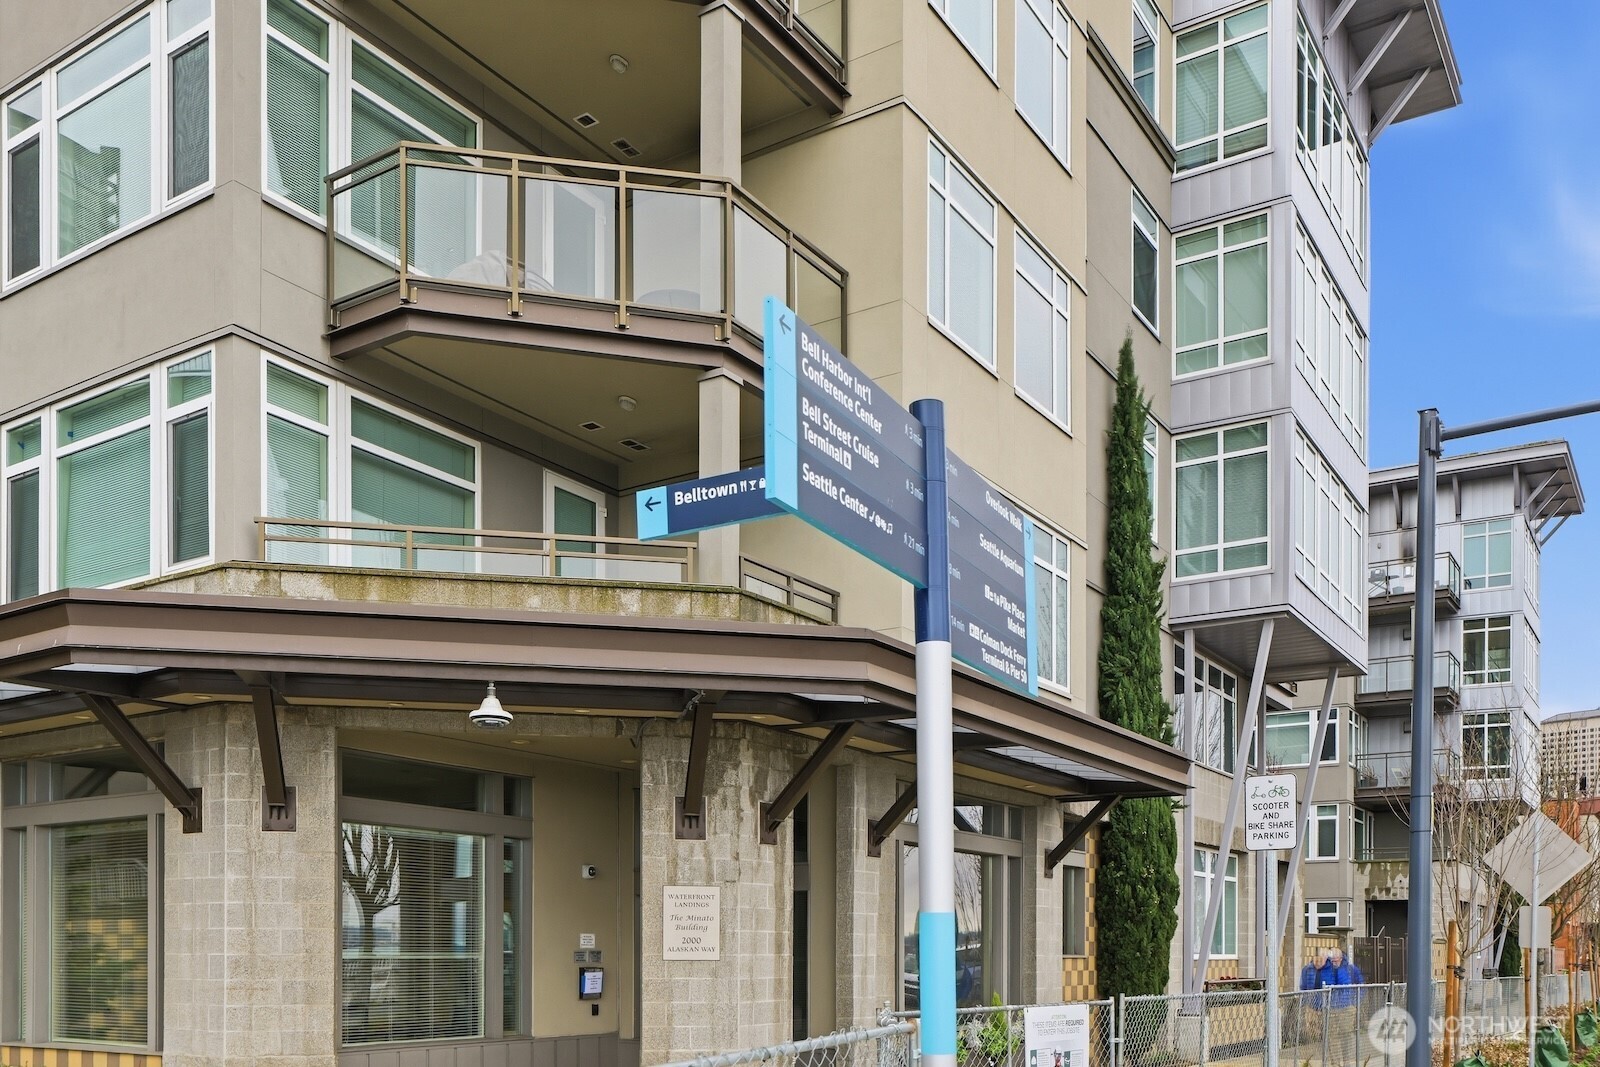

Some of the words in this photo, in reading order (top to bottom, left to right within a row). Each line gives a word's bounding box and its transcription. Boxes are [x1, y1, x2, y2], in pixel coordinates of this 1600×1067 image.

[802, 332, 820, 362] Bell
[822, 350, 853, 388] Harbor
[802, 358, 853, 412] Conference
[855, 401, 882, 435] Center
[802, 397, 821, 426] Bell
[823, 413, 852, 448] Street
[853, 436, 879, 468] Cruise
[802, 421, 842, 466] Terminal
[913, 433, 923, 448] min
[674, 482, 738, 506] Belltown
[802, 463, 838, 500] Seattle
[839, 487, 869, 519] Center
[914, 488, 924, 501] min
[985, 490, 1010, 521] Overlook
[1010, 511, 1022, 532] Walk
[908, 536, 915, 550] 21
[915, 543, 925, 556] min
[980, 533, 1000, 559] Seattle
[1000, 549, 1024, 577] Aquarium
[1000, 594, 1011, 613] Pike
[1011, 602, 1025, 622] Place
[1007, 616, 1025, 639] Market
[980, 629, 1000, 652] Colman
[1000, 641, 1013, 658] Dock
[1013, 649, 1026, 669] Ferry
[982, 648, 1005, 672] Terminal
[1010, 662, 1020, 680] Pier
[1252, 801, 1289, 811] SCOOTER
[1262, 812, 1280, 820] AND
[1248, 822, 1265, 831] BIKE
[1268, 820, 1294, 829] SHARE
[1252, 831, 1289, 840] PARKING
[675, 923, 708, 933] Building
[681, 936, 702, 944] 2000
[1065, 1019, 1084, 1027] REQUIRED
